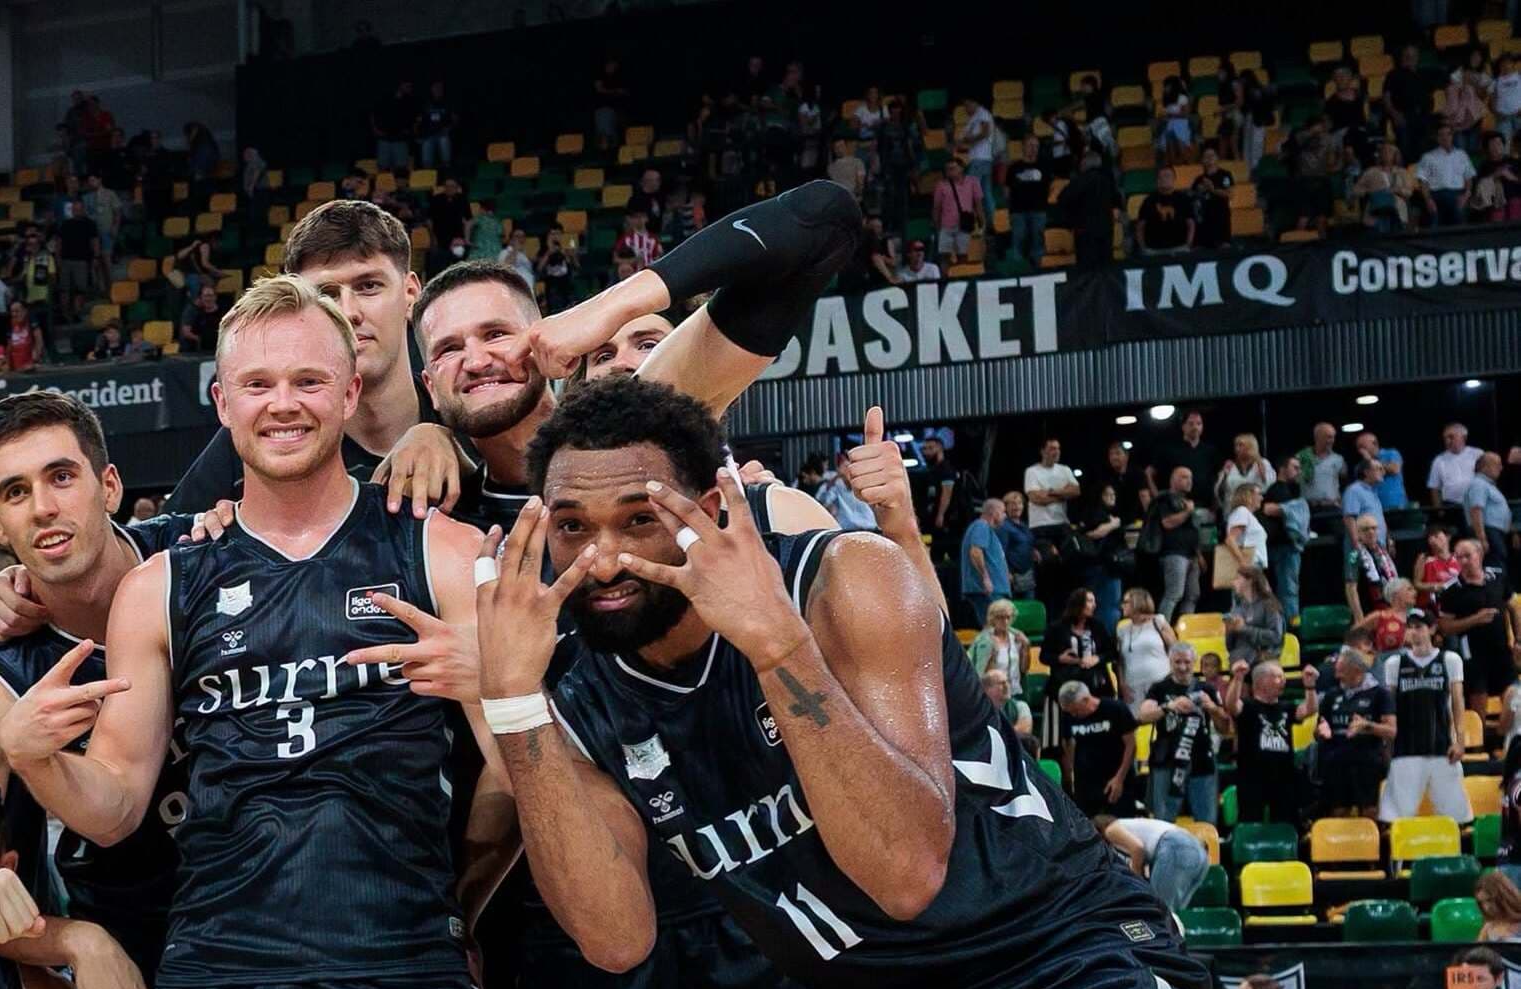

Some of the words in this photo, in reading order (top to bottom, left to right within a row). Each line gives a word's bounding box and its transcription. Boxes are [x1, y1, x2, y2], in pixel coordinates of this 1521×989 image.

[1123, 254, 1297, 311] IMQ
[41, 378, 165, 410] cident
[276, 700, 317, 759] 3
[652, 804, 685, 825] hummel
[666, 784, 814, 881] urn
[776, 882, 864, 961] 11
